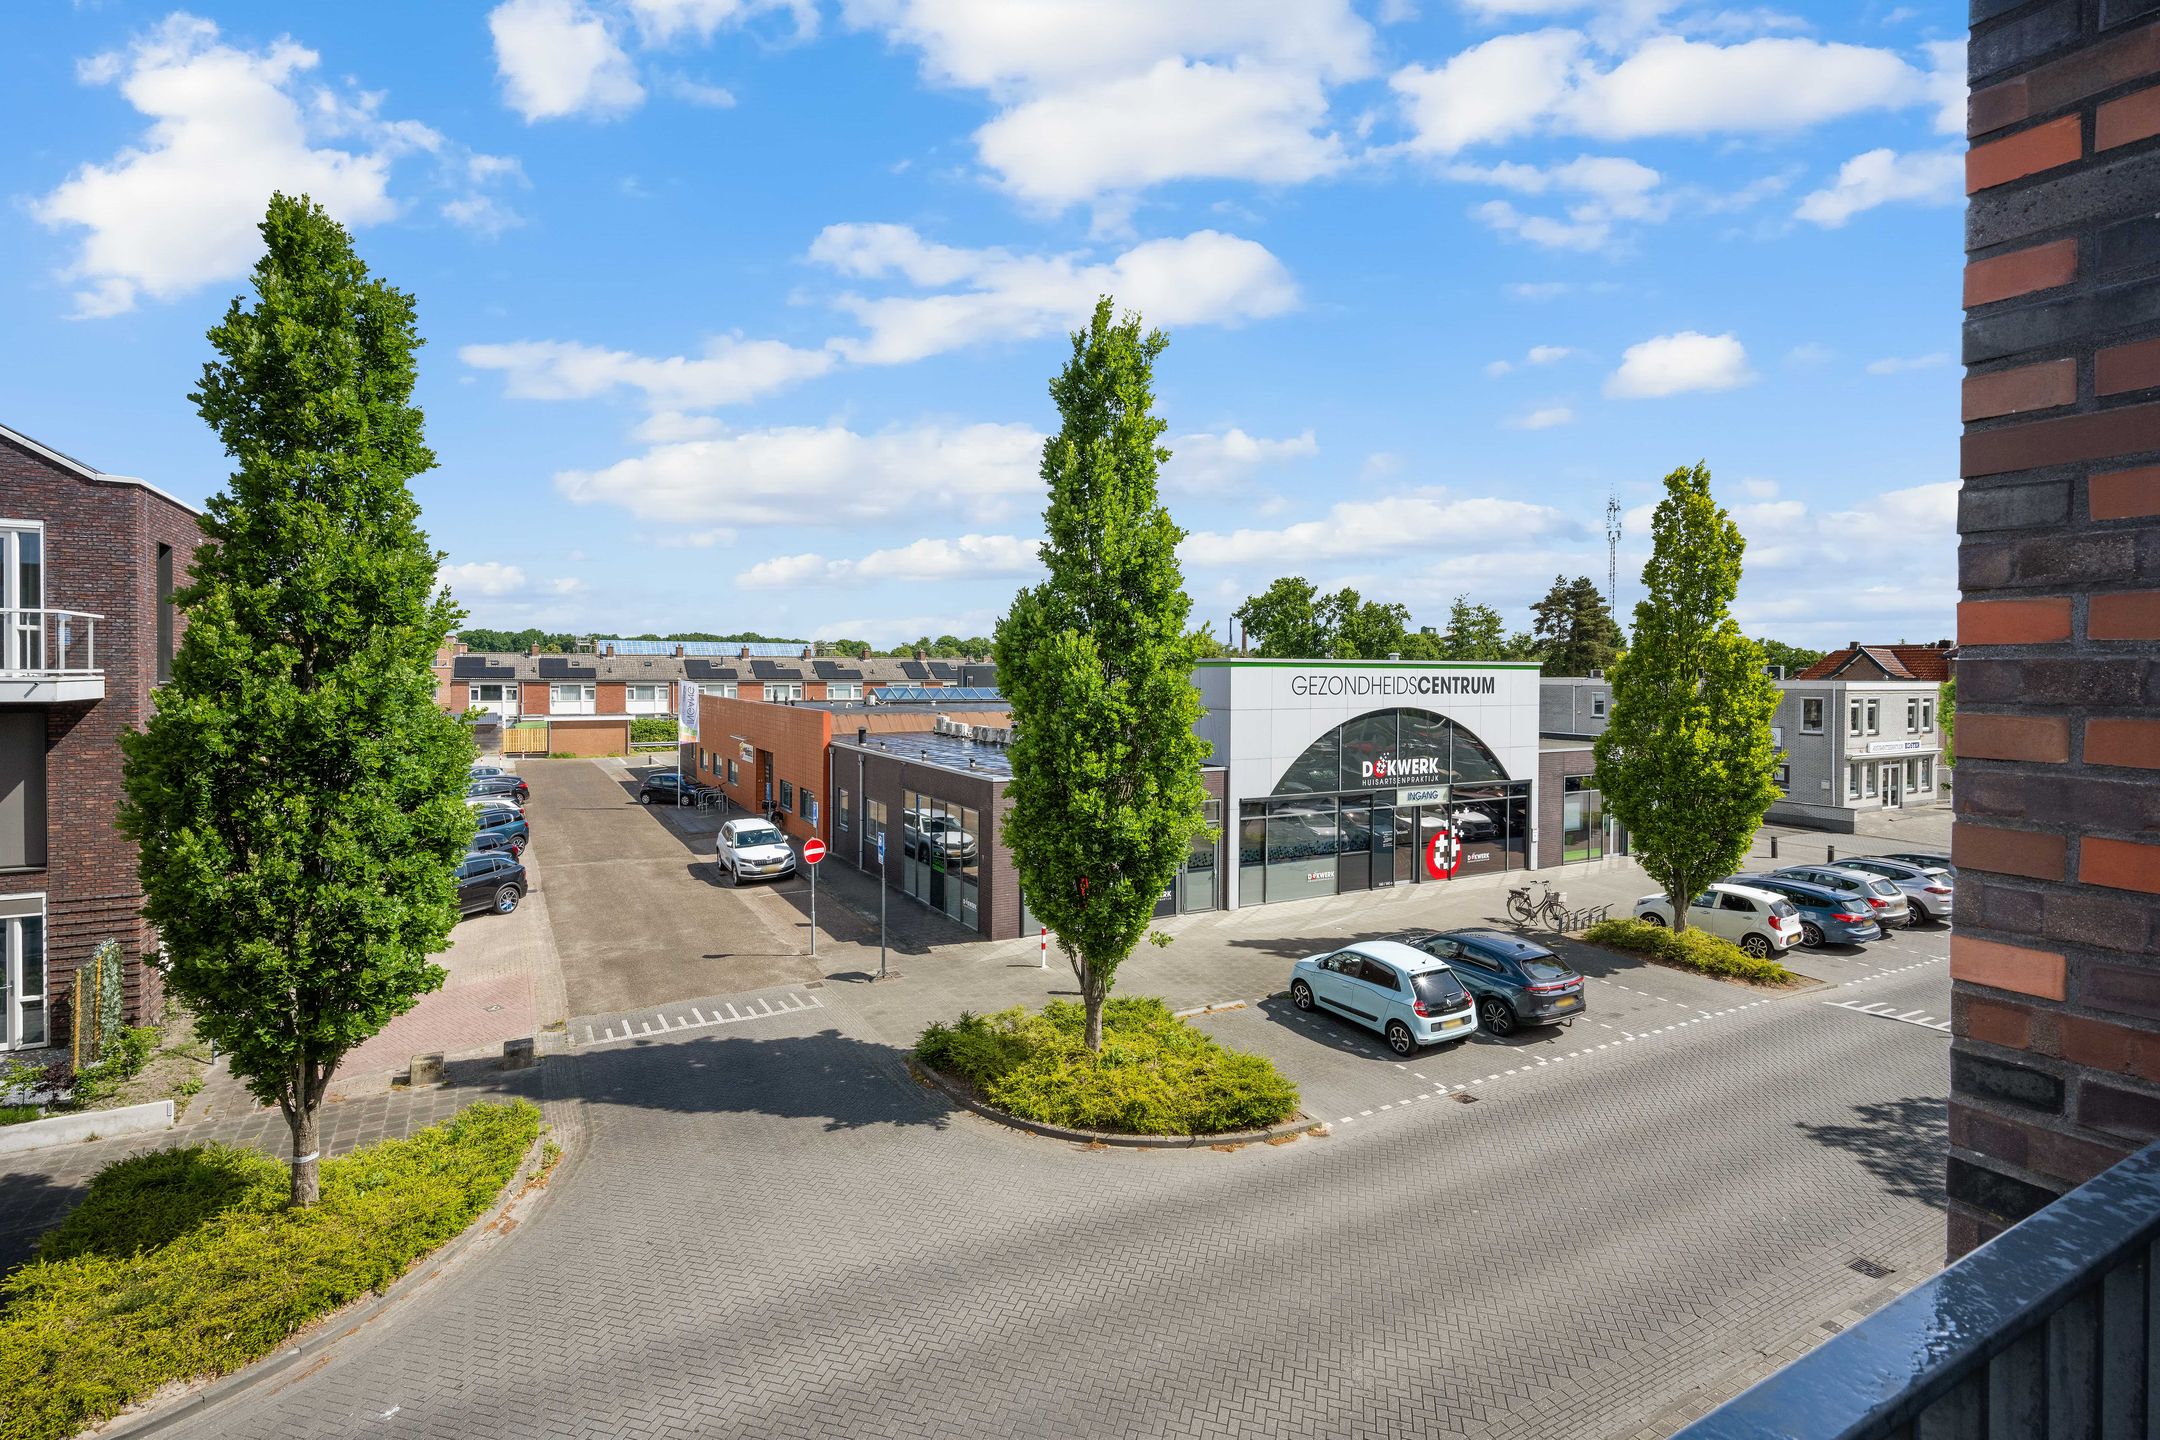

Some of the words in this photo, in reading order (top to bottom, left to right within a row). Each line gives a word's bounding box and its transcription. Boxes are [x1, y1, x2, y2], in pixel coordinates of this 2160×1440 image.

[1291, 675, 1495, 695] GEZONDHEIDSCENTRUM
[1362, 757, 1439, 778] DOKWERK
[1362, 775, 1439, 786] HUISARTSENPRAKTIJK
[1407, 790, 1439, 801] INGANG
